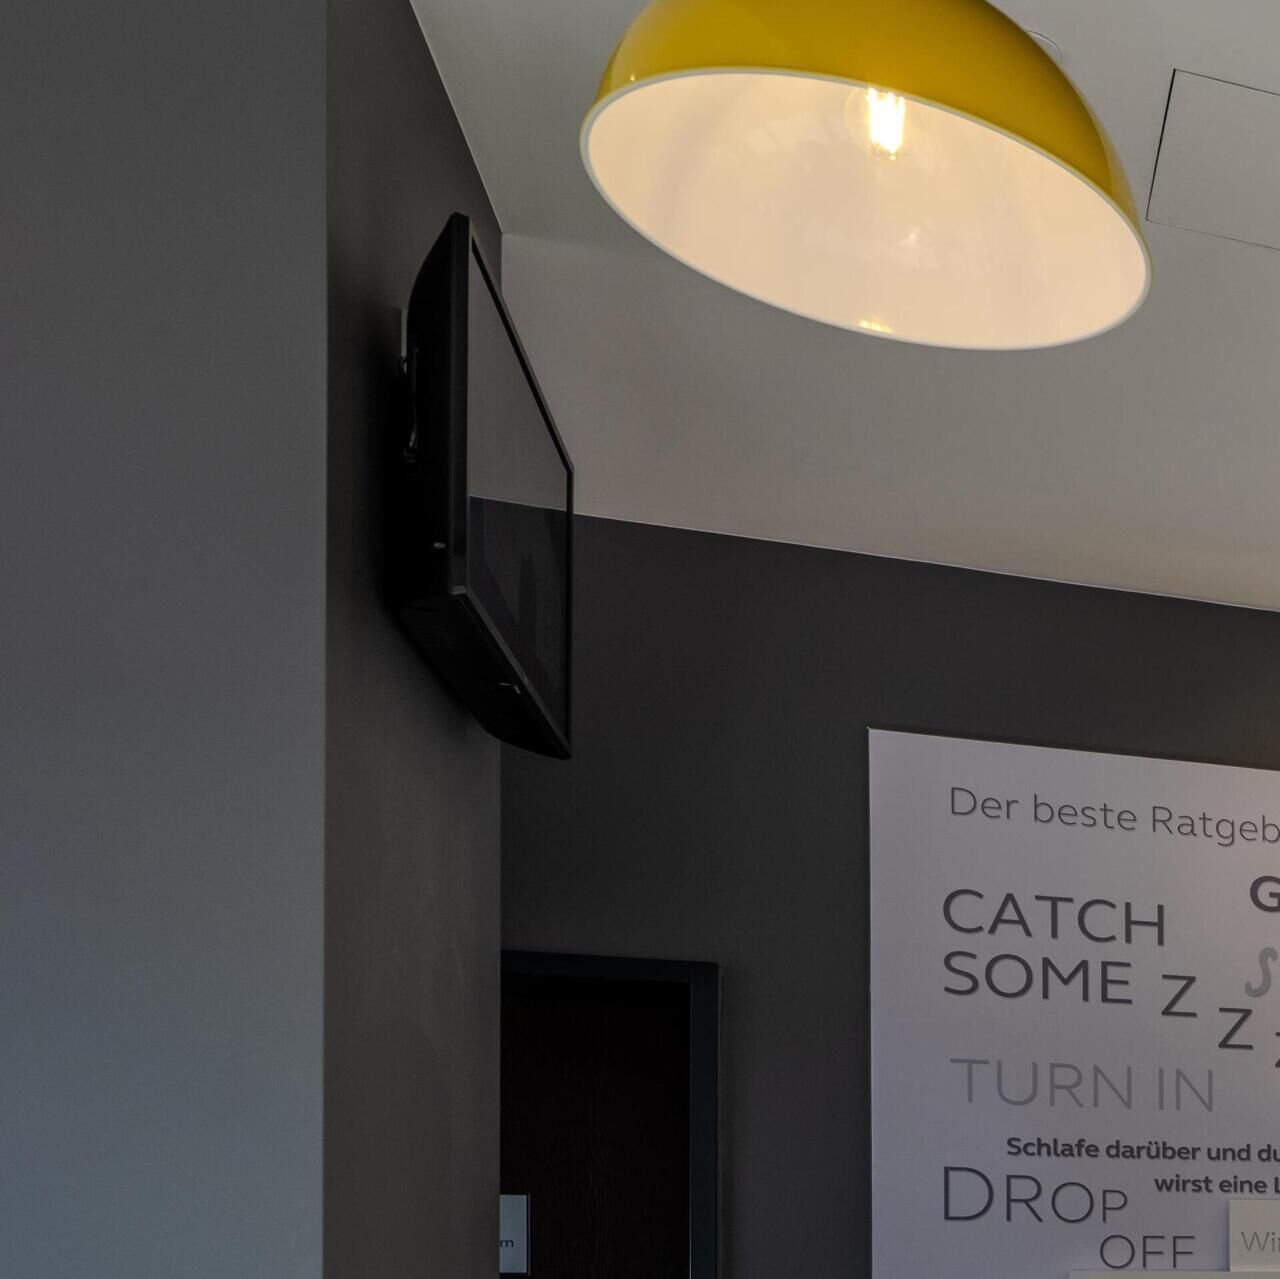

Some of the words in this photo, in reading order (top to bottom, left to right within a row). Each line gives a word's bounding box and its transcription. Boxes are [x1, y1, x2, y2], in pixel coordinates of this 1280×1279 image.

[950, 786, 1019, 820] Der
[1033, 793, 1138, 832] beste
[942, 888, 1165, 947] CATCH
[943, 950, 1133, 1006] SOME
[1160, 973, 1198, 1019] Z
[1217, 1006, 1254, 1051] Z
[949, 1057, 1133, 1110] TURN
[1158, 1066, 1214, 1113] IN
[1006, 1136, 1101, 1159] Schlafe
[1105, 1139, 1201, 1161] darüber
[1206, 1143, 1252, 1163] und
[943, 1165, 1129, 1225] DROP
[1153, 1173, 1214, 1194] wirst
[1217, 1171, 1268, 1195] eine
[1099, 1234, 1196, 1271] OFF
